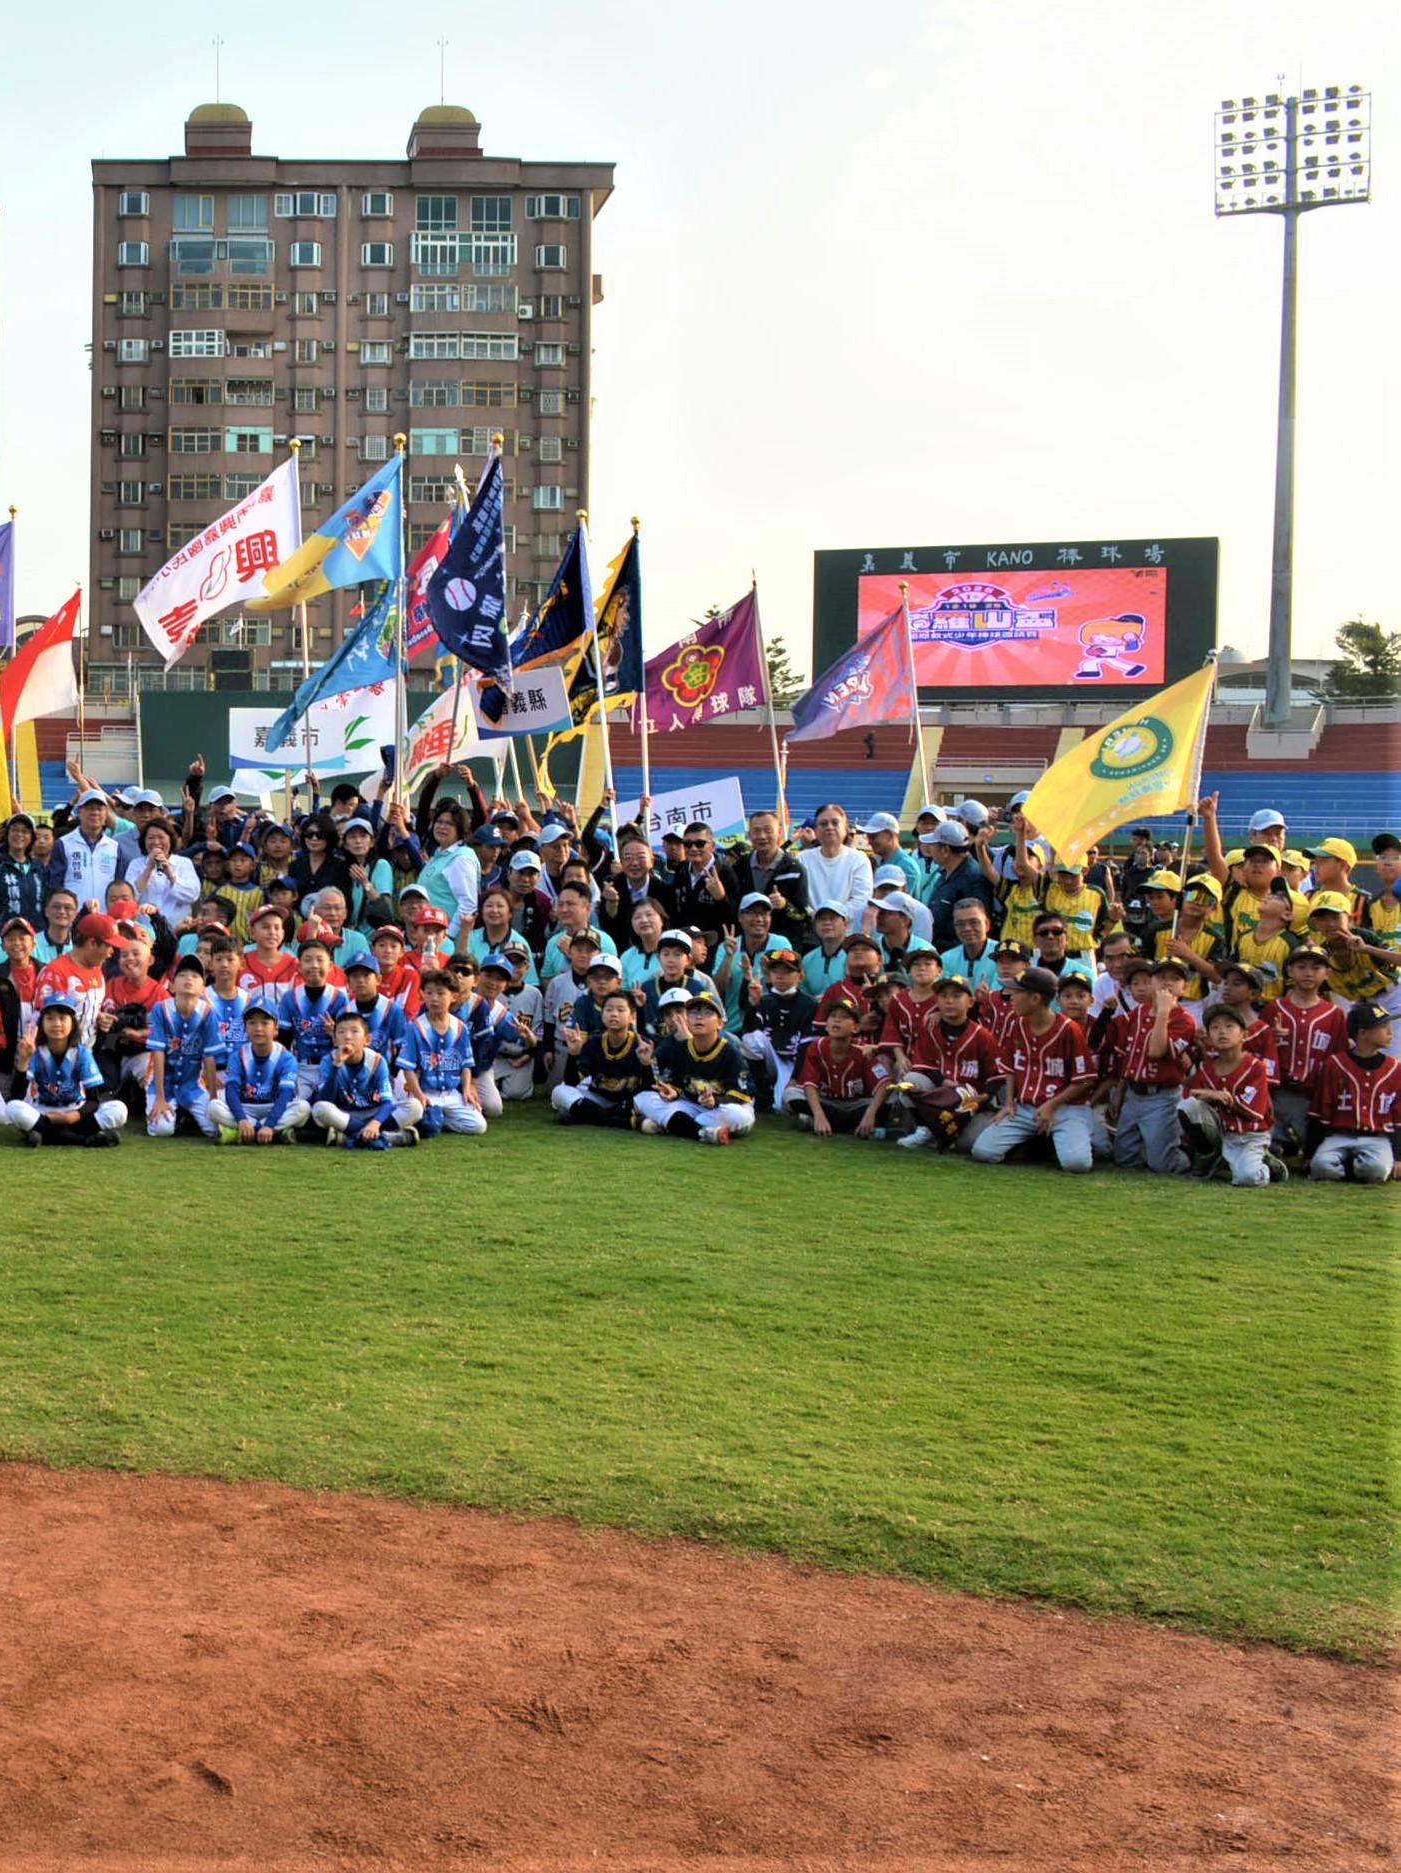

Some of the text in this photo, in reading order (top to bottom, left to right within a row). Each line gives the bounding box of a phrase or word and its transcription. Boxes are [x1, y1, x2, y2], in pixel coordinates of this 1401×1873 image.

[986, 549, 1034, 568] KANO
[1056, 544, 1165, 566] 棒球場
[501, 687, 548, 715] 義縣
[649, 801, 713, 833] 台南市
